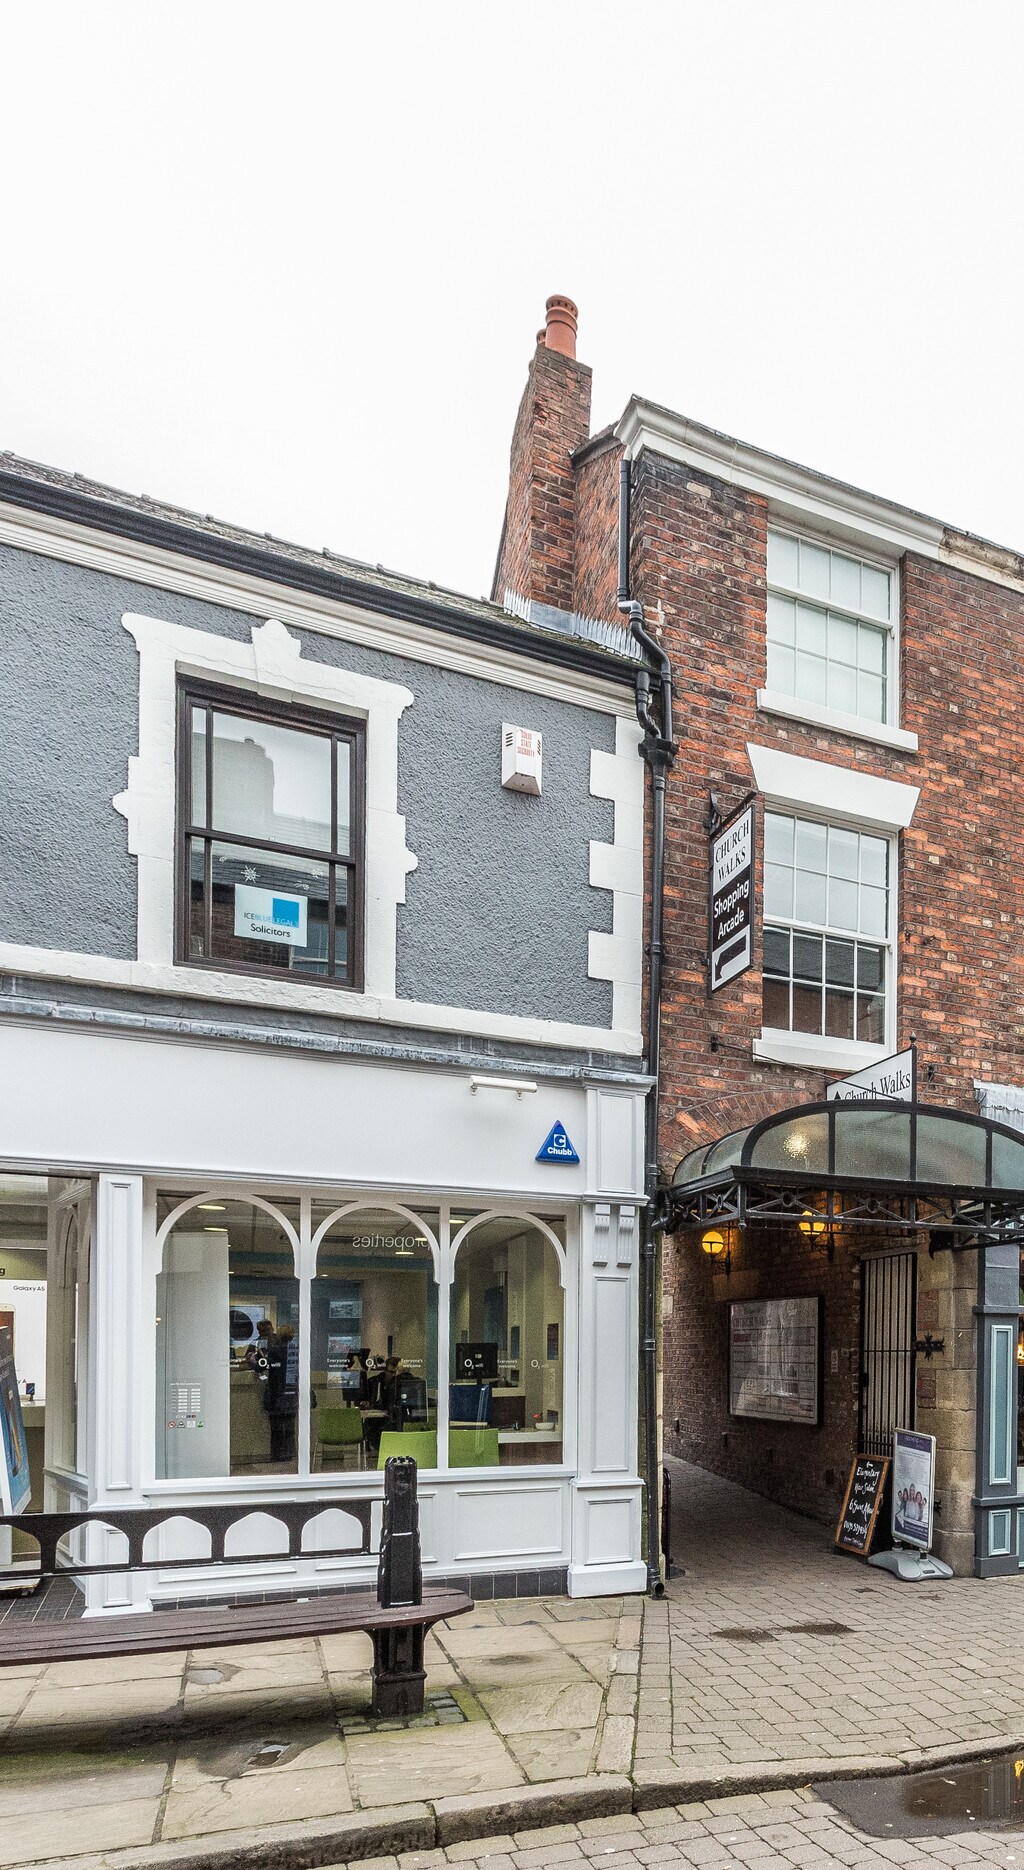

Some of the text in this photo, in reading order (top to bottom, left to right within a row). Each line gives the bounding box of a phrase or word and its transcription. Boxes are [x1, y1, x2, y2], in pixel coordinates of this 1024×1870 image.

[715, 820, 750, 863] CHURCH
[718, 846, 746, 882] WALKS
[714, 879, 749, 919] Shopping
[250, 923, 291, 938] Solicitors
[717, 907, 745, 940] Arcade
[845, 1070, 911, 1100] Church Walks
[547, 1147, 573, 1156] Chubb
